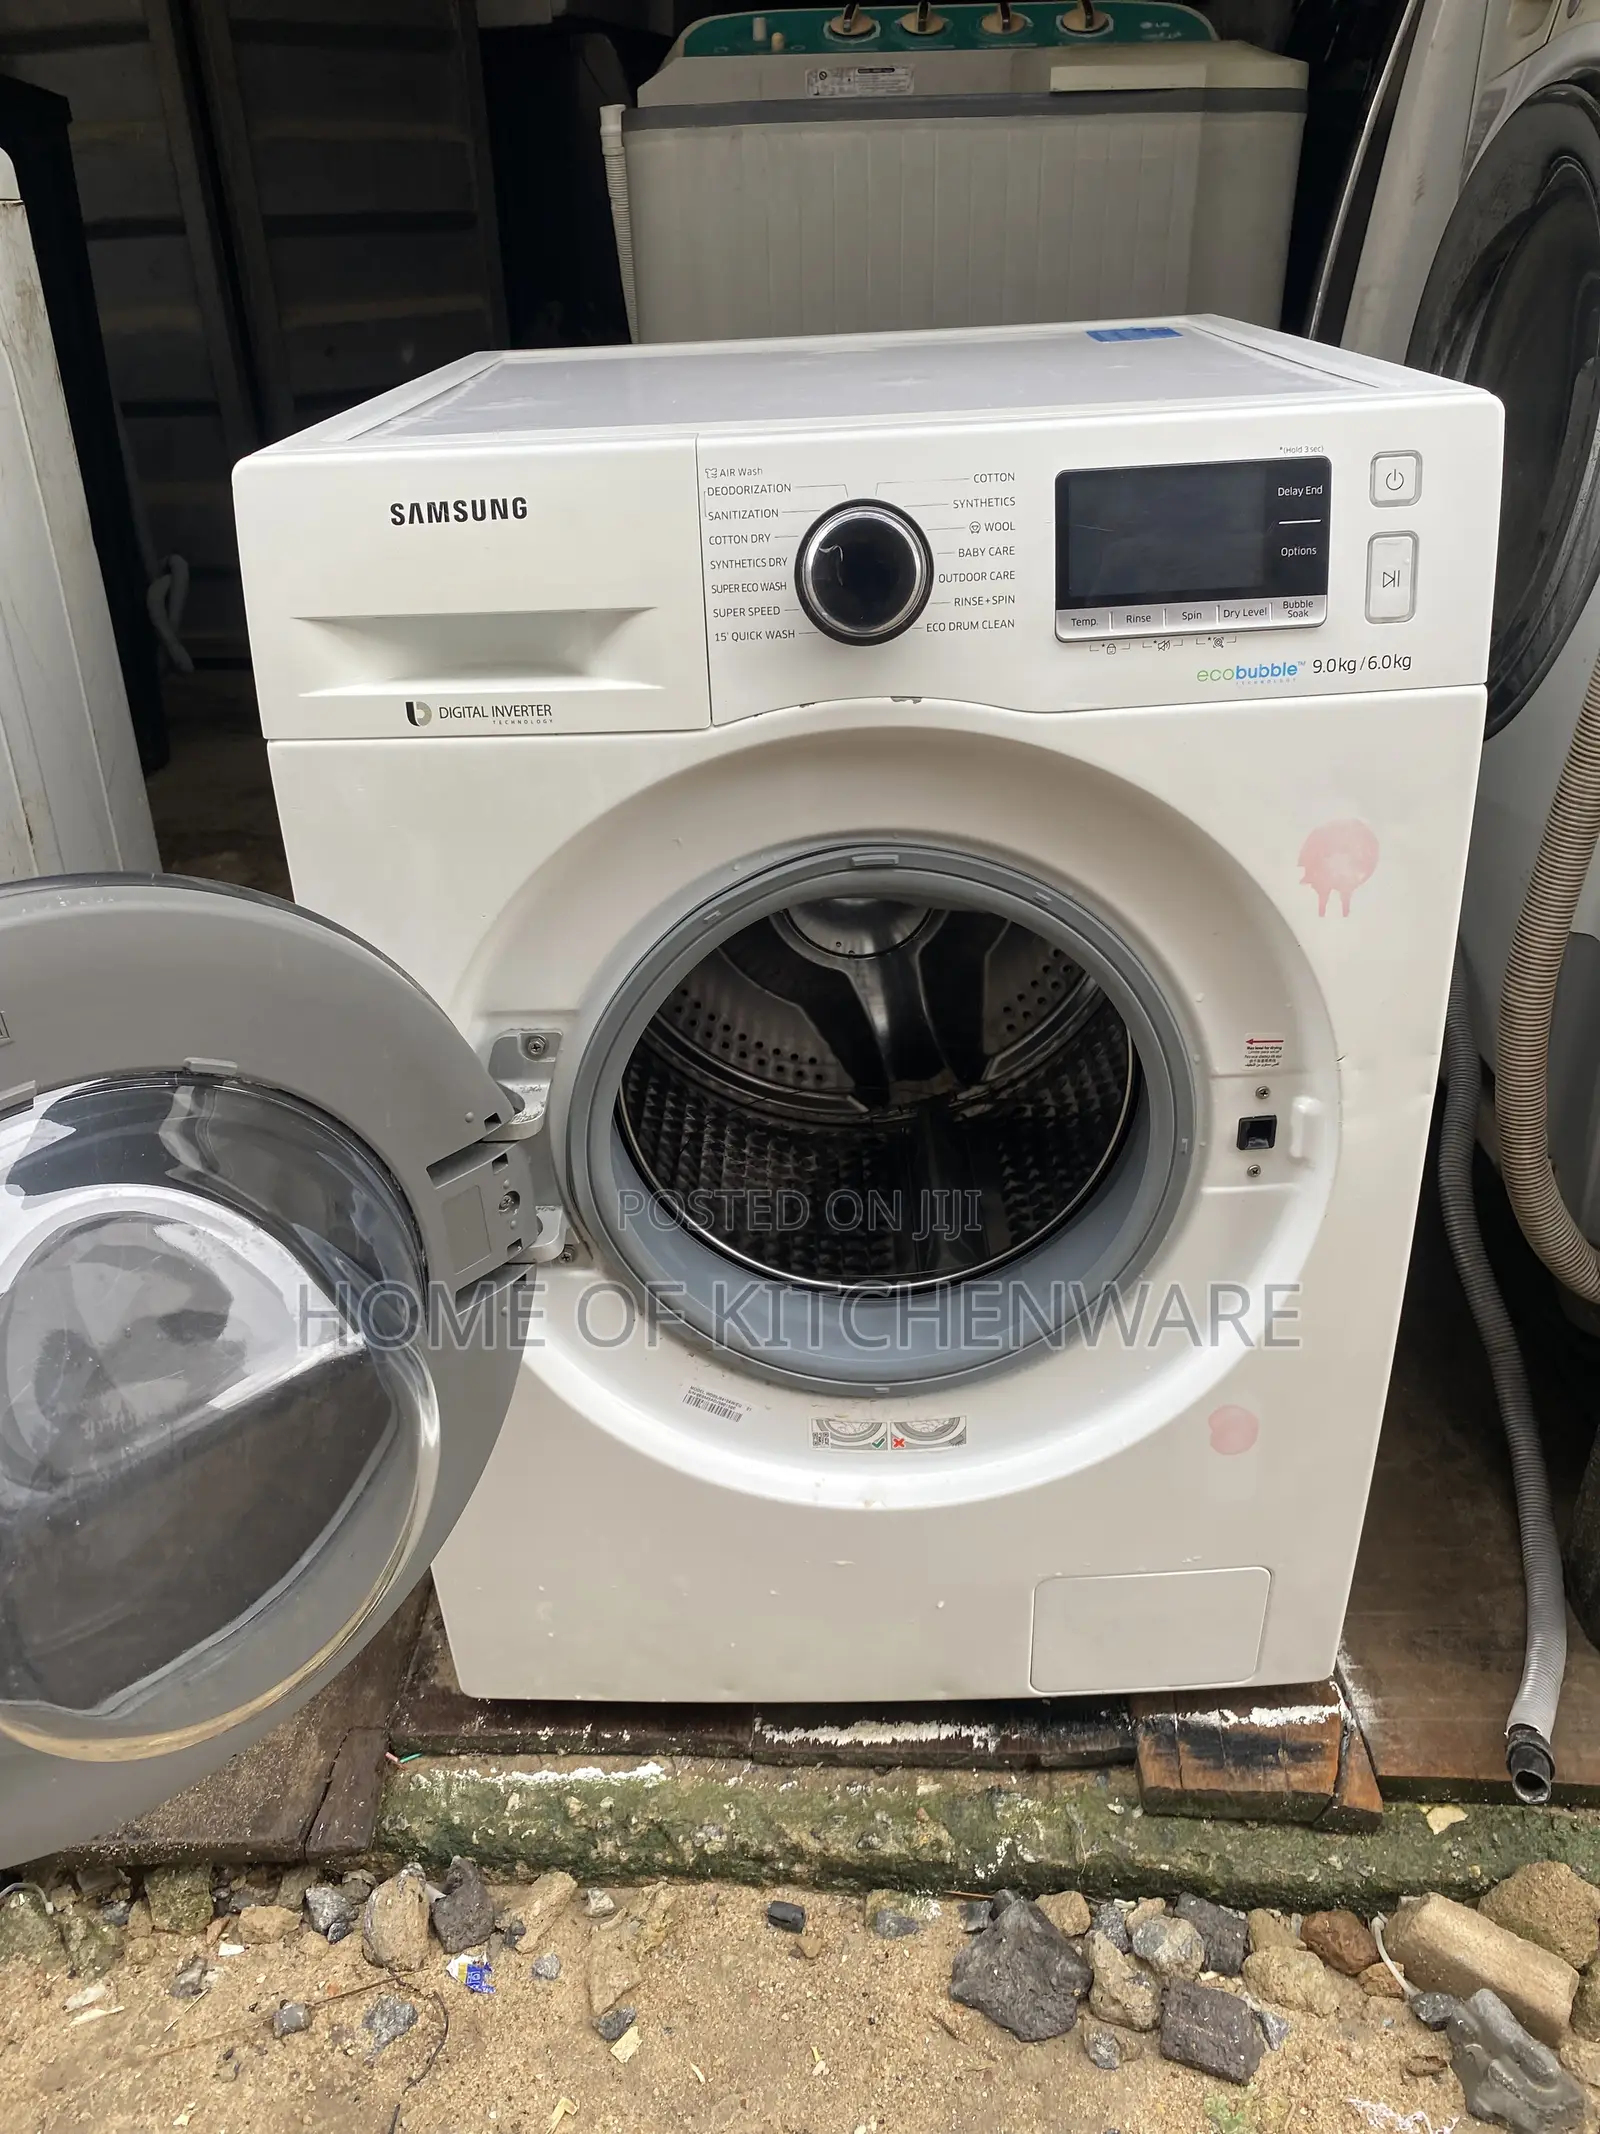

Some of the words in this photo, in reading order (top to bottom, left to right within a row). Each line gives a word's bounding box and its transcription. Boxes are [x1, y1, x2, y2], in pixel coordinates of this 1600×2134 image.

[719, 468, 736, 477] AIR
[738, 467, 763, 476] Wash
[973, 472, 1015, 483] COTTON
[707, 483, 792, 496] DEODORIZATION
[1278, 485, 1304, 498] Delay
[1306, 484, 1323, 495] End
[953, 497, 1016, 509] SYNTHETICS
[390, 496, 528, 526] SAMSUNG
[708, 509, 779, 521] SANITIZATION
[984, 521, 1016, 532] WOOL
[709, 534, 748, 545] COTTON
[751, 533, 771, 543] DRY
[958, 547, 986, 558] BABY
[988, 546, 1016, 557] CARE
[1281, 545, 1317, 557] Options
[710, 558, 767, 569] SYNTHETICS
[769, 557, 788, 567] DRY
[938, 572, 987, 583] OUTDOOR
[989, 570, 1016, 581] CARE
[711, 583, 740, 594] SUPER
[741, 582, 759, 593] ECO
[760, 581, 787, 592] WASH
[954, 596, 984, 607] RINSE
[992, 594, 1016, 605] SPIN
[1282, 599, 1314, 609] Bubble
[713, 607, 746, 618] SUPER
[748, 606, 781, 616] SPEED
[1126, 612, 1152, 624] Rinse
[1182, 610, 1202, 622] Spin
[1223, 609, 1241, 619] Dry
[1242, 606, 1268, 618] Level
[1287, 609, 1309, 618] Soak
[926, 622, 946, 633] ECO
[948, 620, 979, 631] DRUM
[981, 619, 1015, 630] CLEAN
[1071, 616, 1099, 628] Temp.
[731, 631, 763, 642] QUICK
[765, 629, 796, 640] WASH
[438, 705, 489, 719] DIGITAL
[491, 704, 552, 717] INVERTER
